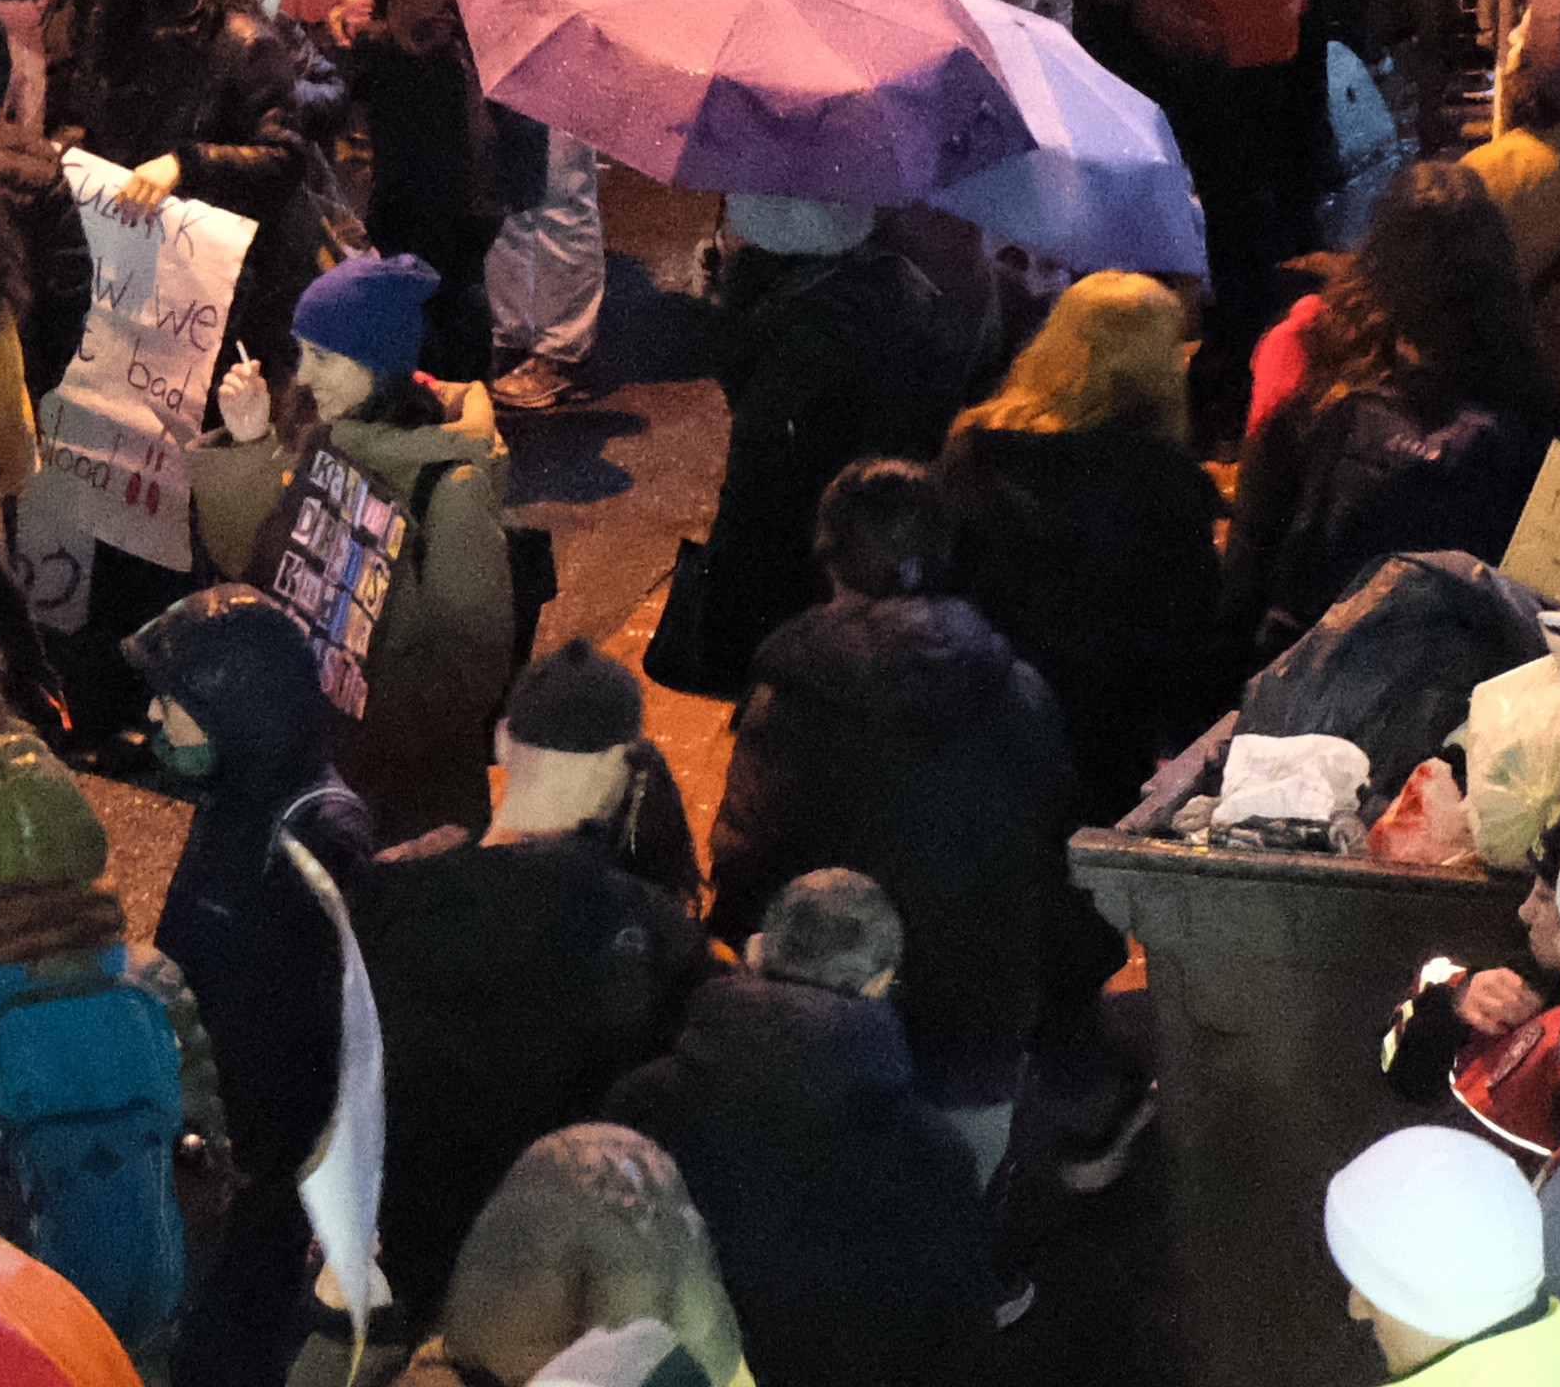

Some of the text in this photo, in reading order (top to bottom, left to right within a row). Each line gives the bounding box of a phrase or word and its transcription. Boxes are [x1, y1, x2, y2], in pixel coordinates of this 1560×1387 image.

[155, 282, 219, 353] we
[125, 337, 194, 413] bad
[40, 404, 121, 491] lood
